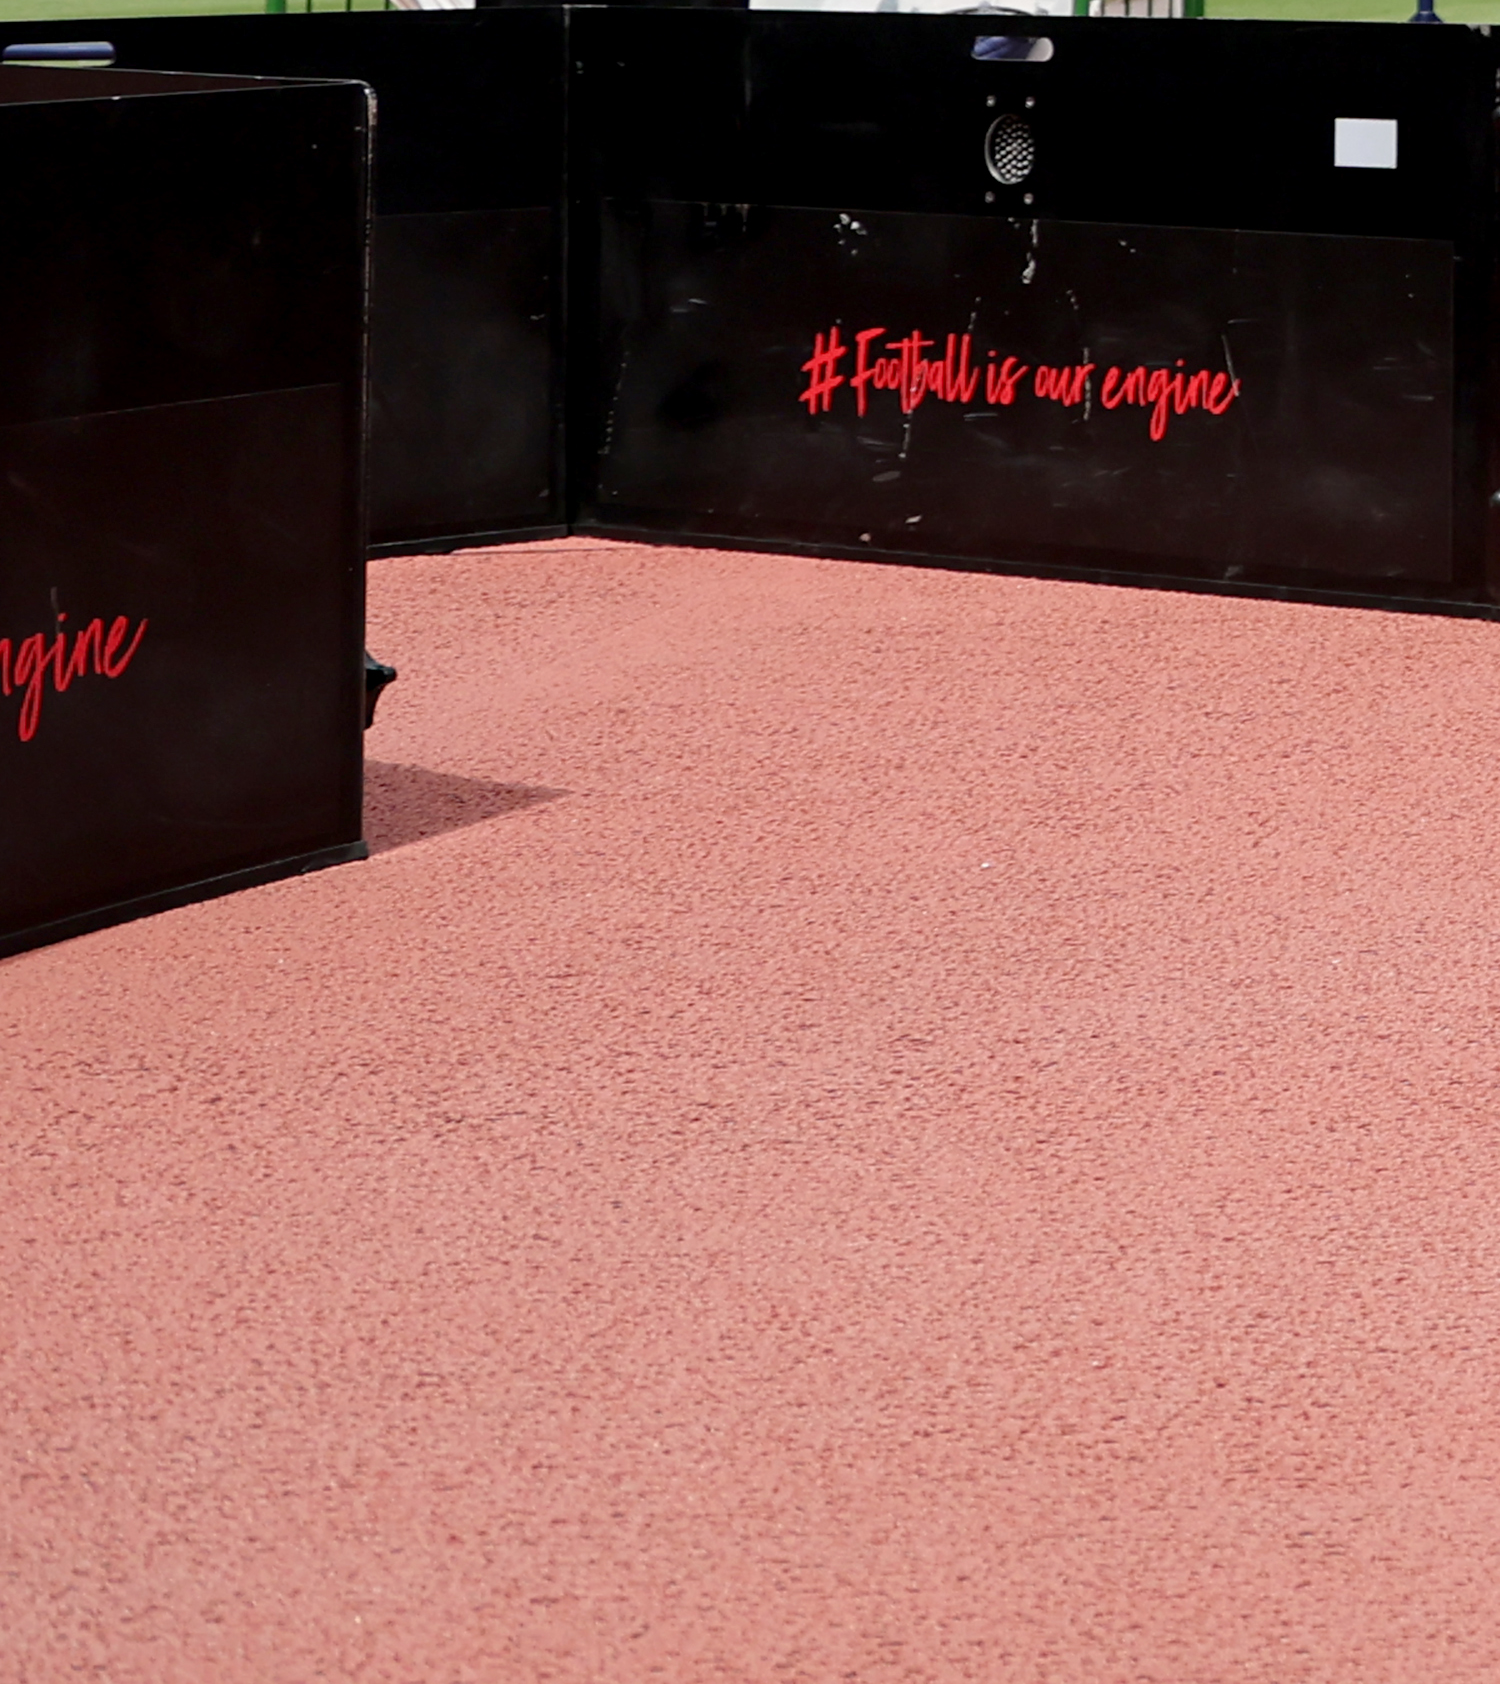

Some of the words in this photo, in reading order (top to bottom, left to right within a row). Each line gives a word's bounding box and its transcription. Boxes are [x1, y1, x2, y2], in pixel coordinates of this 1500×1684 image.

[799, 326, 979, 416] #Football
[986, 350, 1029, 405] is
[1034, 362, 1096, 407] our
[1101, 359, 1240, 442] engine
